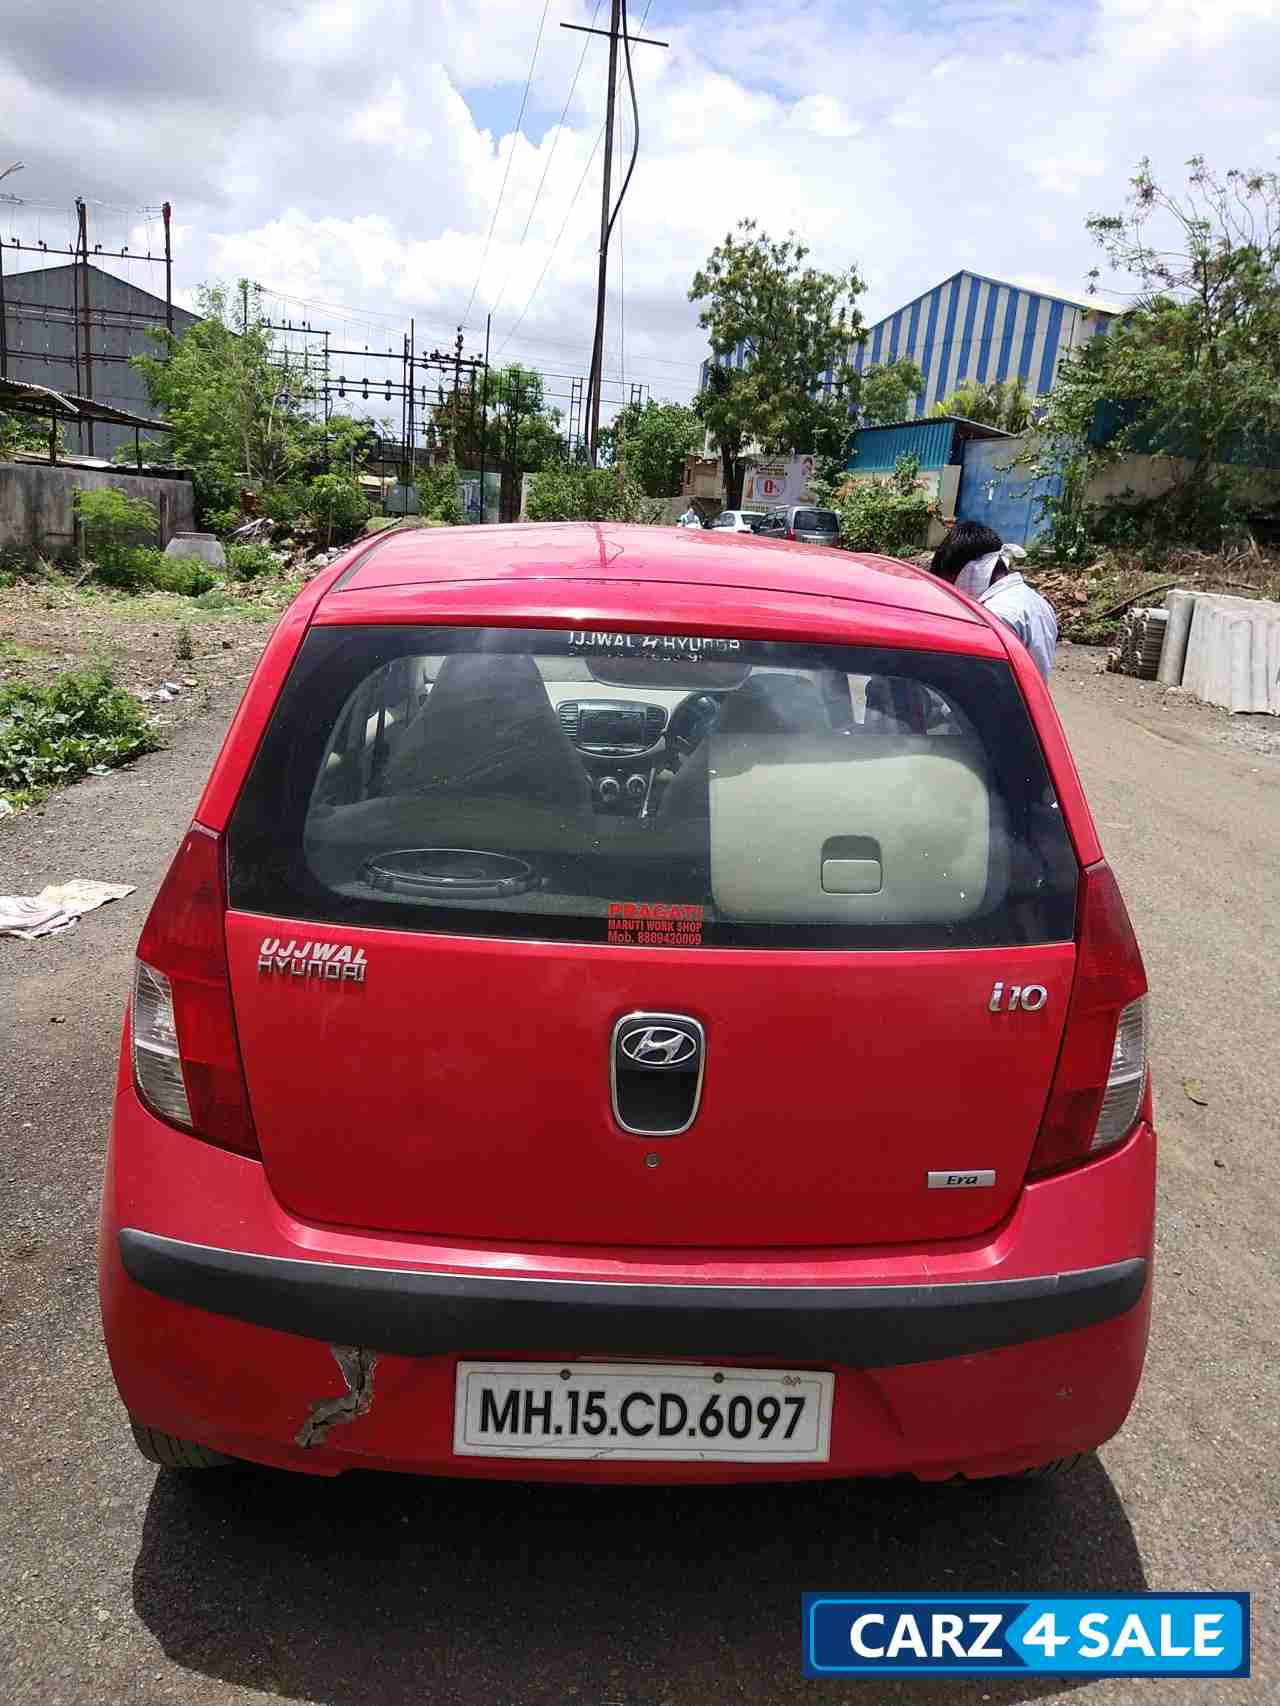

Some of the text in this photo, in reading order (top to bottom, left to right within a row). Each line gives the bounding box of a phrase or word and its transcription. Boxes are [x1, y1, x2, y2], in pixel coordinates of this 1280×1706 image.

[608, 920, 644, 931] MARUTI
[677, 921, 702, 933] SHOP
[260, 938, 368, 965] UJJWAL
[258, 955, 367, 982] HYUNDAI
[988, 981, 1048, 1012] i10
[947, 1174, 979, 1185] Era
[479, 1388, 806, 1439] MH.15.CD.6097
